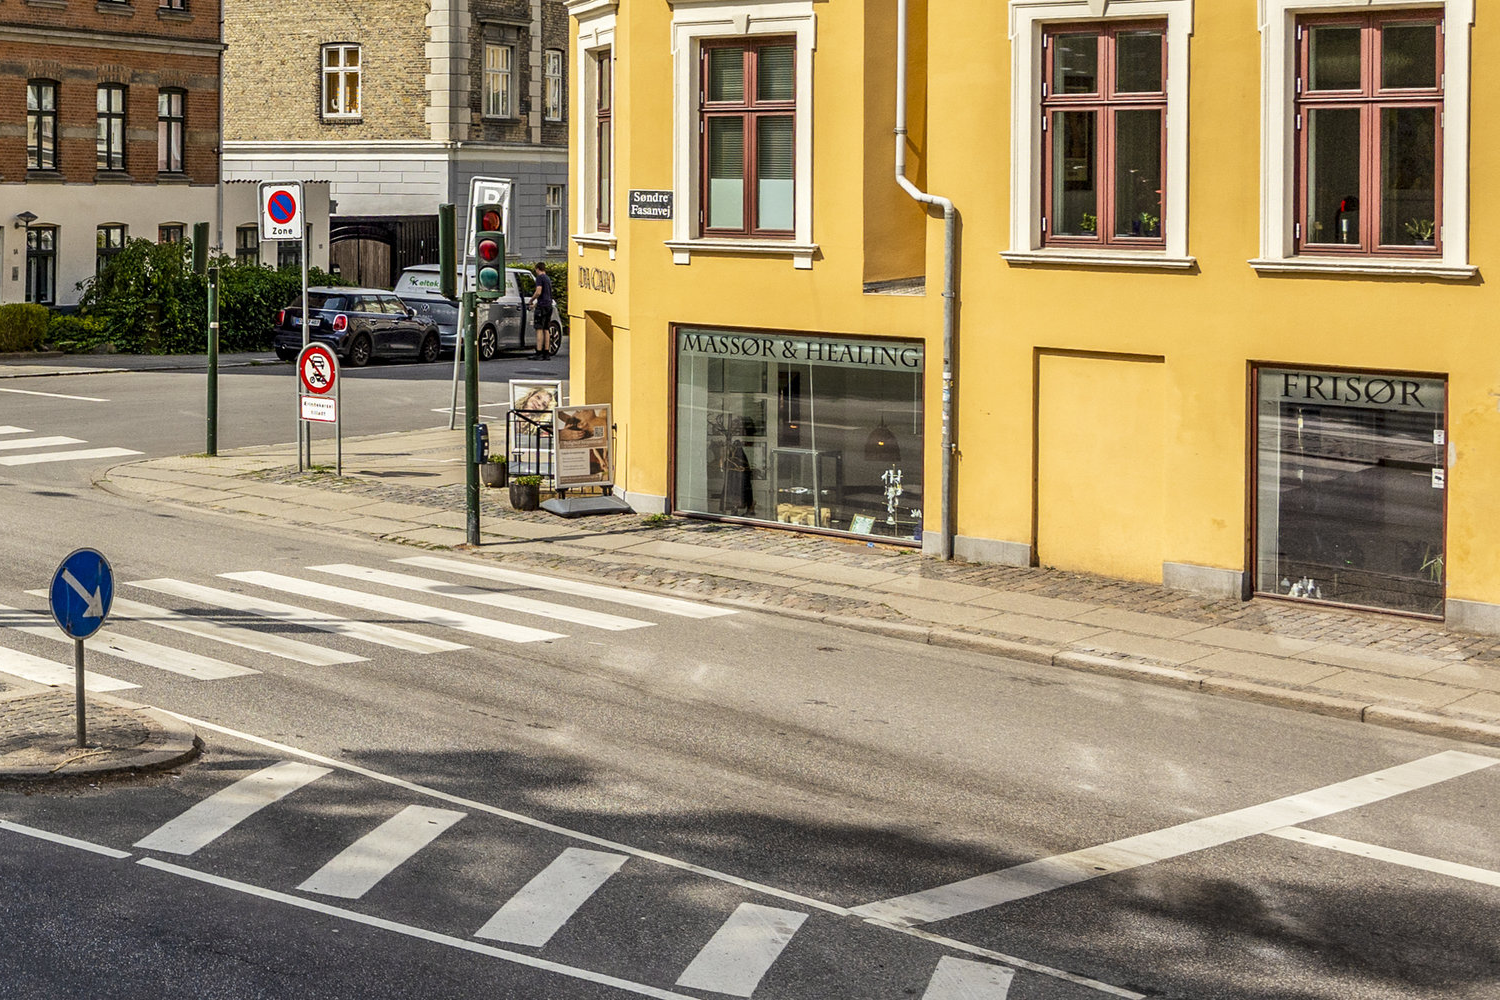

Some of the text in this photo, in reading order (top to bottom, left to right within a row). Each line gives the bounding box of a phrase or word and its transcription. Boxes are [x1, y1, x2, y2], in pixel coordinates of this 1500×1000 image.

[633, 191, 669, 203] Søndre
[631, 204, 671, 218] Fasanvej
[272, 227, 293, 235] Zone
[683, 334, 920, 368] MASSØR & HEALING
[1280, 372, 1425, 408] FRISØR
